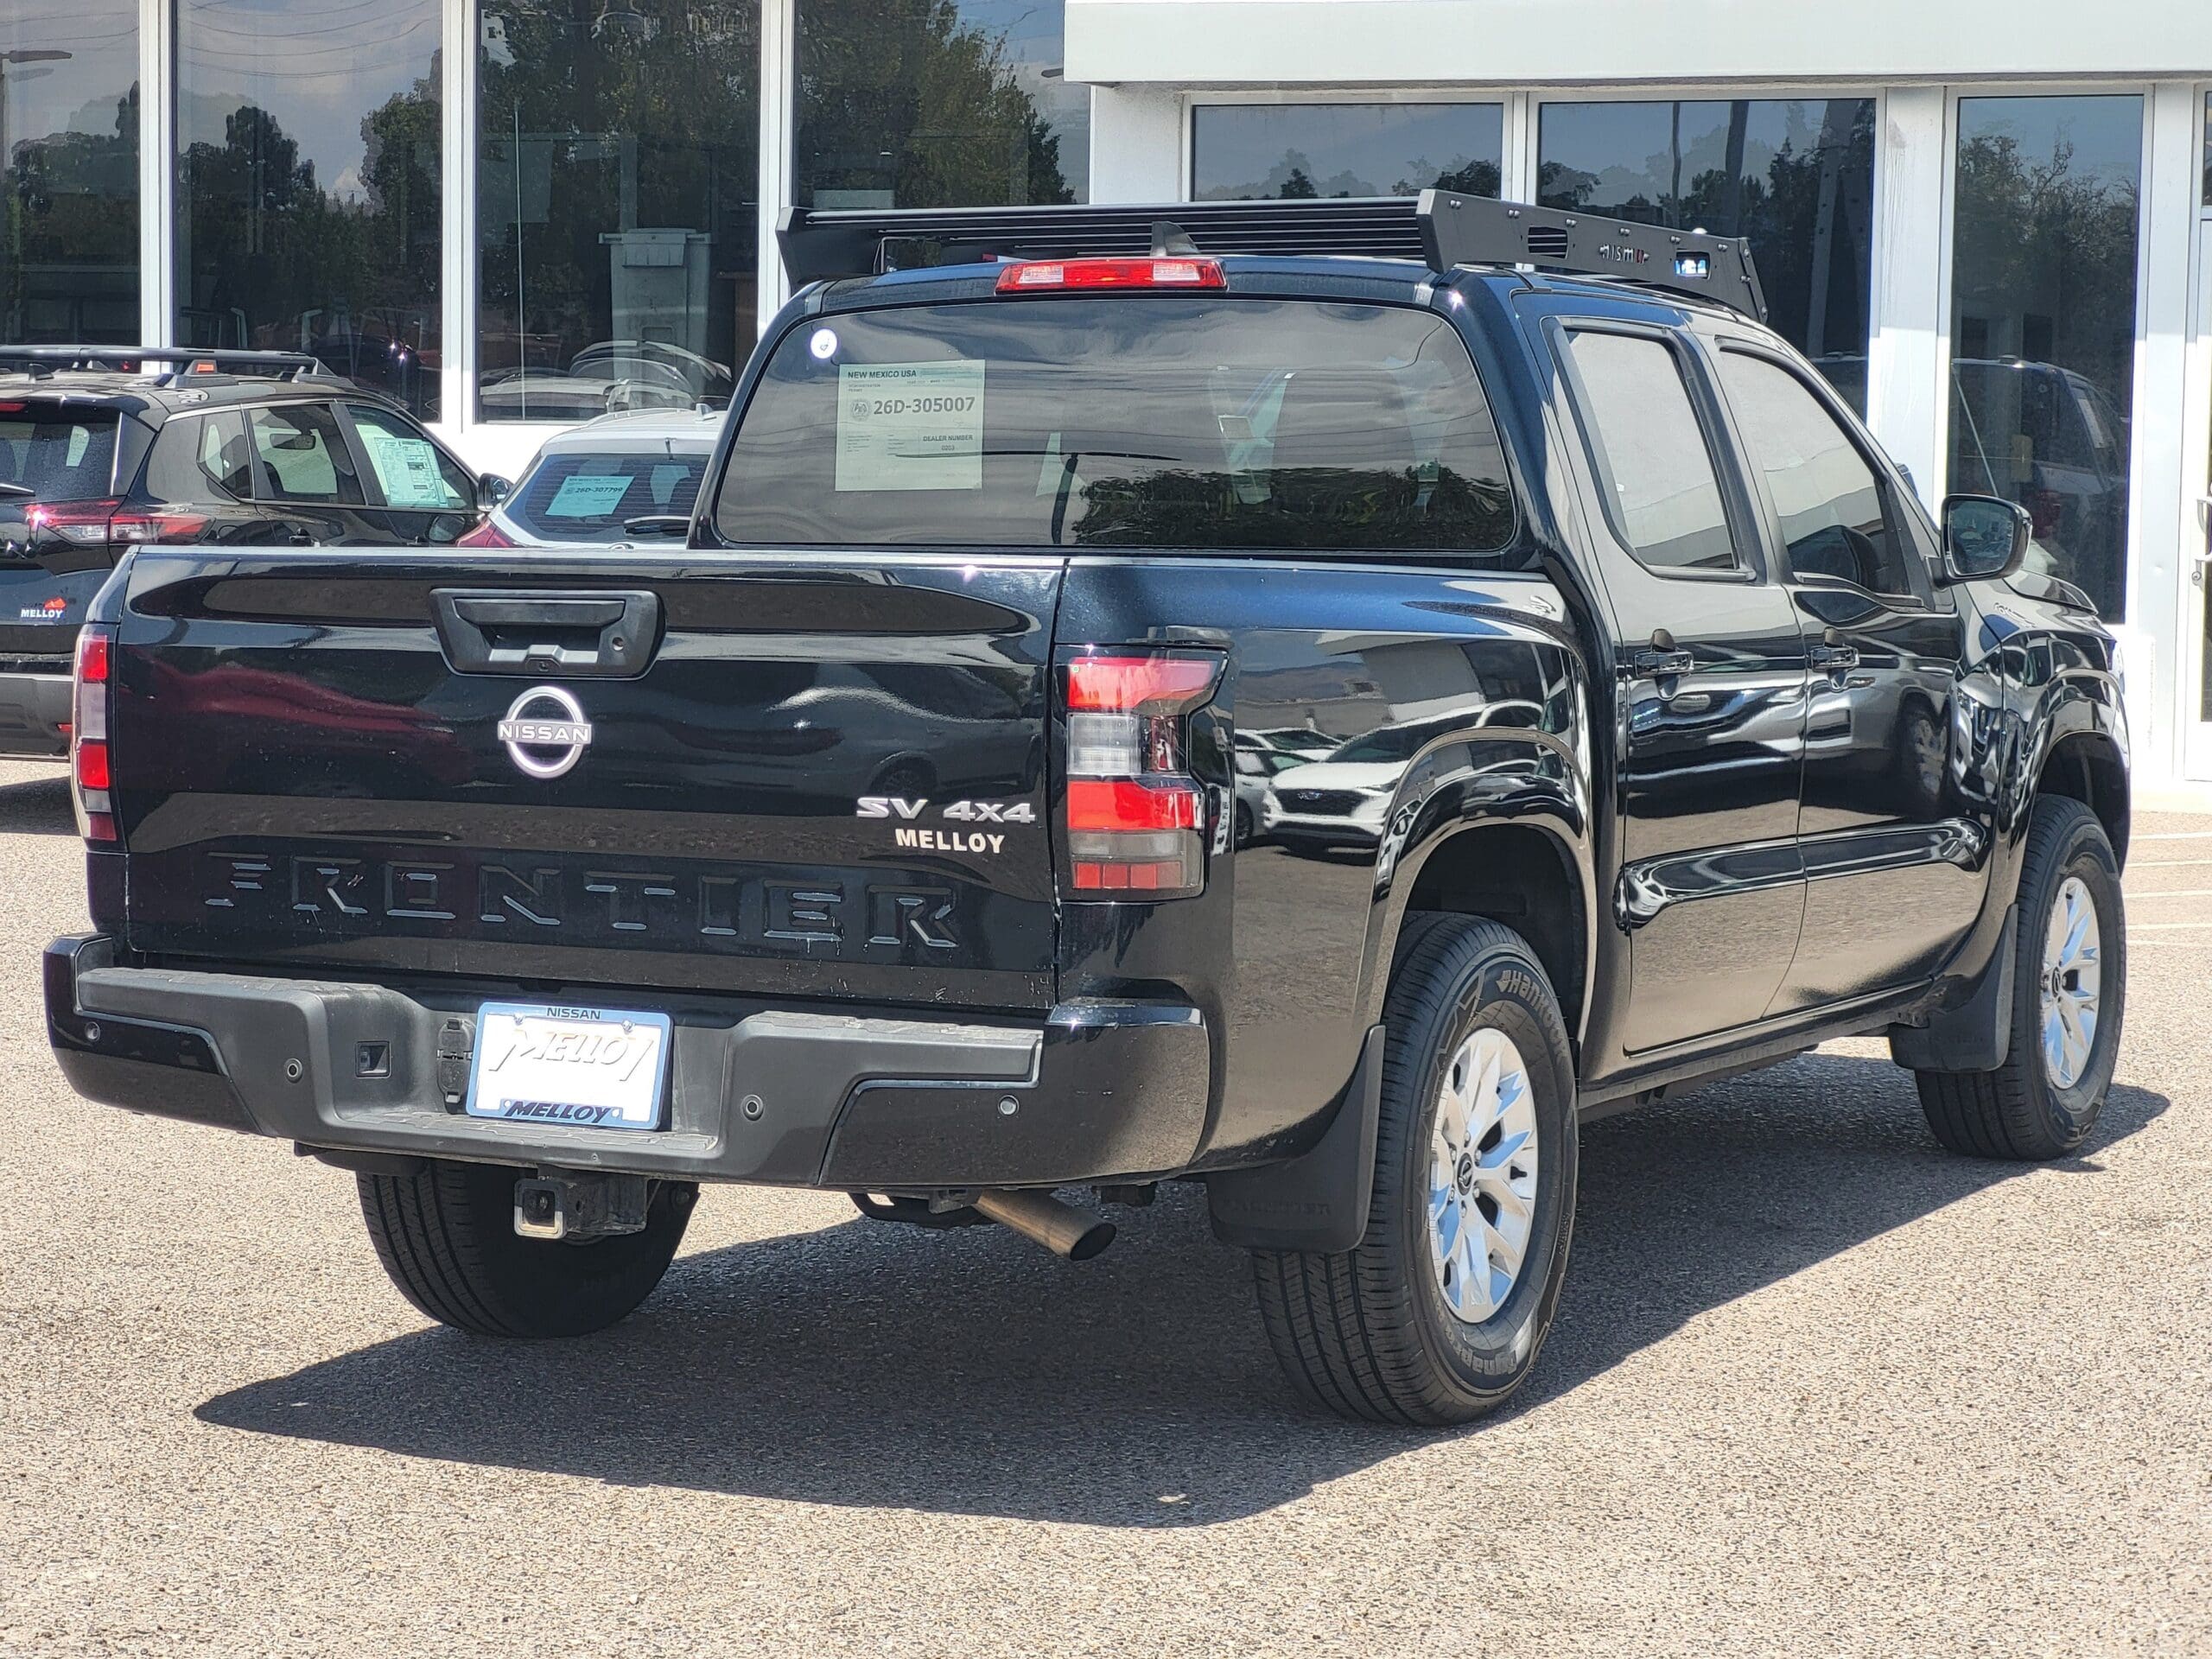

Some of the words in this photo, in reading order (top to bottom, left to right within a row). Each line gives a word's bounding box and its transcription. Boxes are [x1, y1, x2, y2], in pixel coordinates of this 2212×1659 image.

[869, 370, 899, 378] MEXICO
[874, 397, 976, 416] 26D-305007
[21, 608, 63, 618] MELLOY
[499, 724, 589, 742] NISSAN
[856, 797, 929, 820] SV
[895, 829, 1006, 855] MELLOY
[205, 851, 959, 949] FRONTIER
[546, 1007, 601, 1020] NISSAN
[505, 1100, 612, 1124] MELLOY
